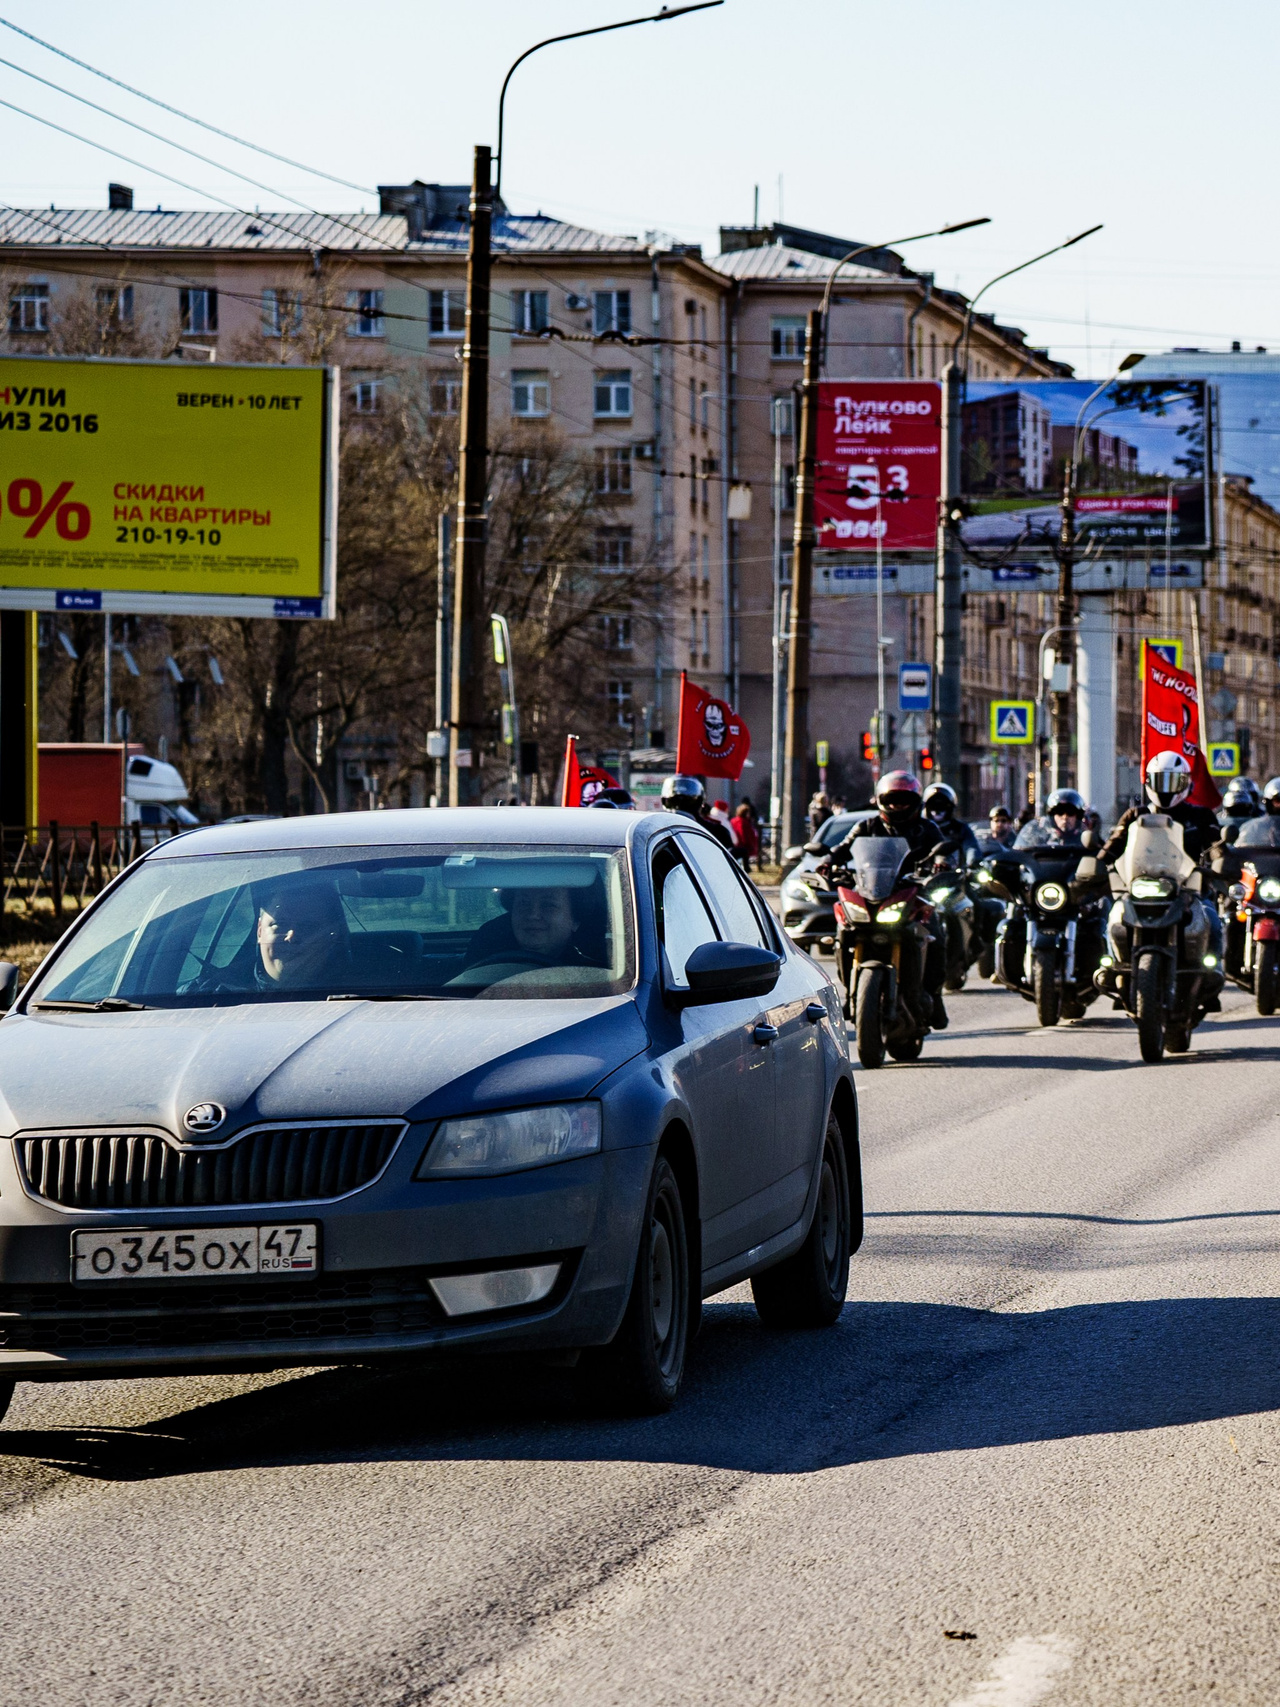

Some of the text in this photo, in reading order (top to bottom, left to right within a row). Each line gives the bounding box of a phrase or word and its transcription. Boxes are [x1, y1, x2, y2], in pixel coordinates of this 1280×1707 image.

[176, 391, 303, 411] ВЕРЕН 10 ЛЕТ
[834, 396, 932, 419] Пулково
[0, 411, 99, 434] ИЗ 2016
[833, 415, 892, 434] Лейк
[113, 482, 205, 504] СКИДКИ
[113, 504, 272, 526] НА КВАРТИРЫ
[115, 526, 222, 546] 210-19-10
[264, 1229, 303, 1257] 47
[261, 1258, 291, 1269] RUS
